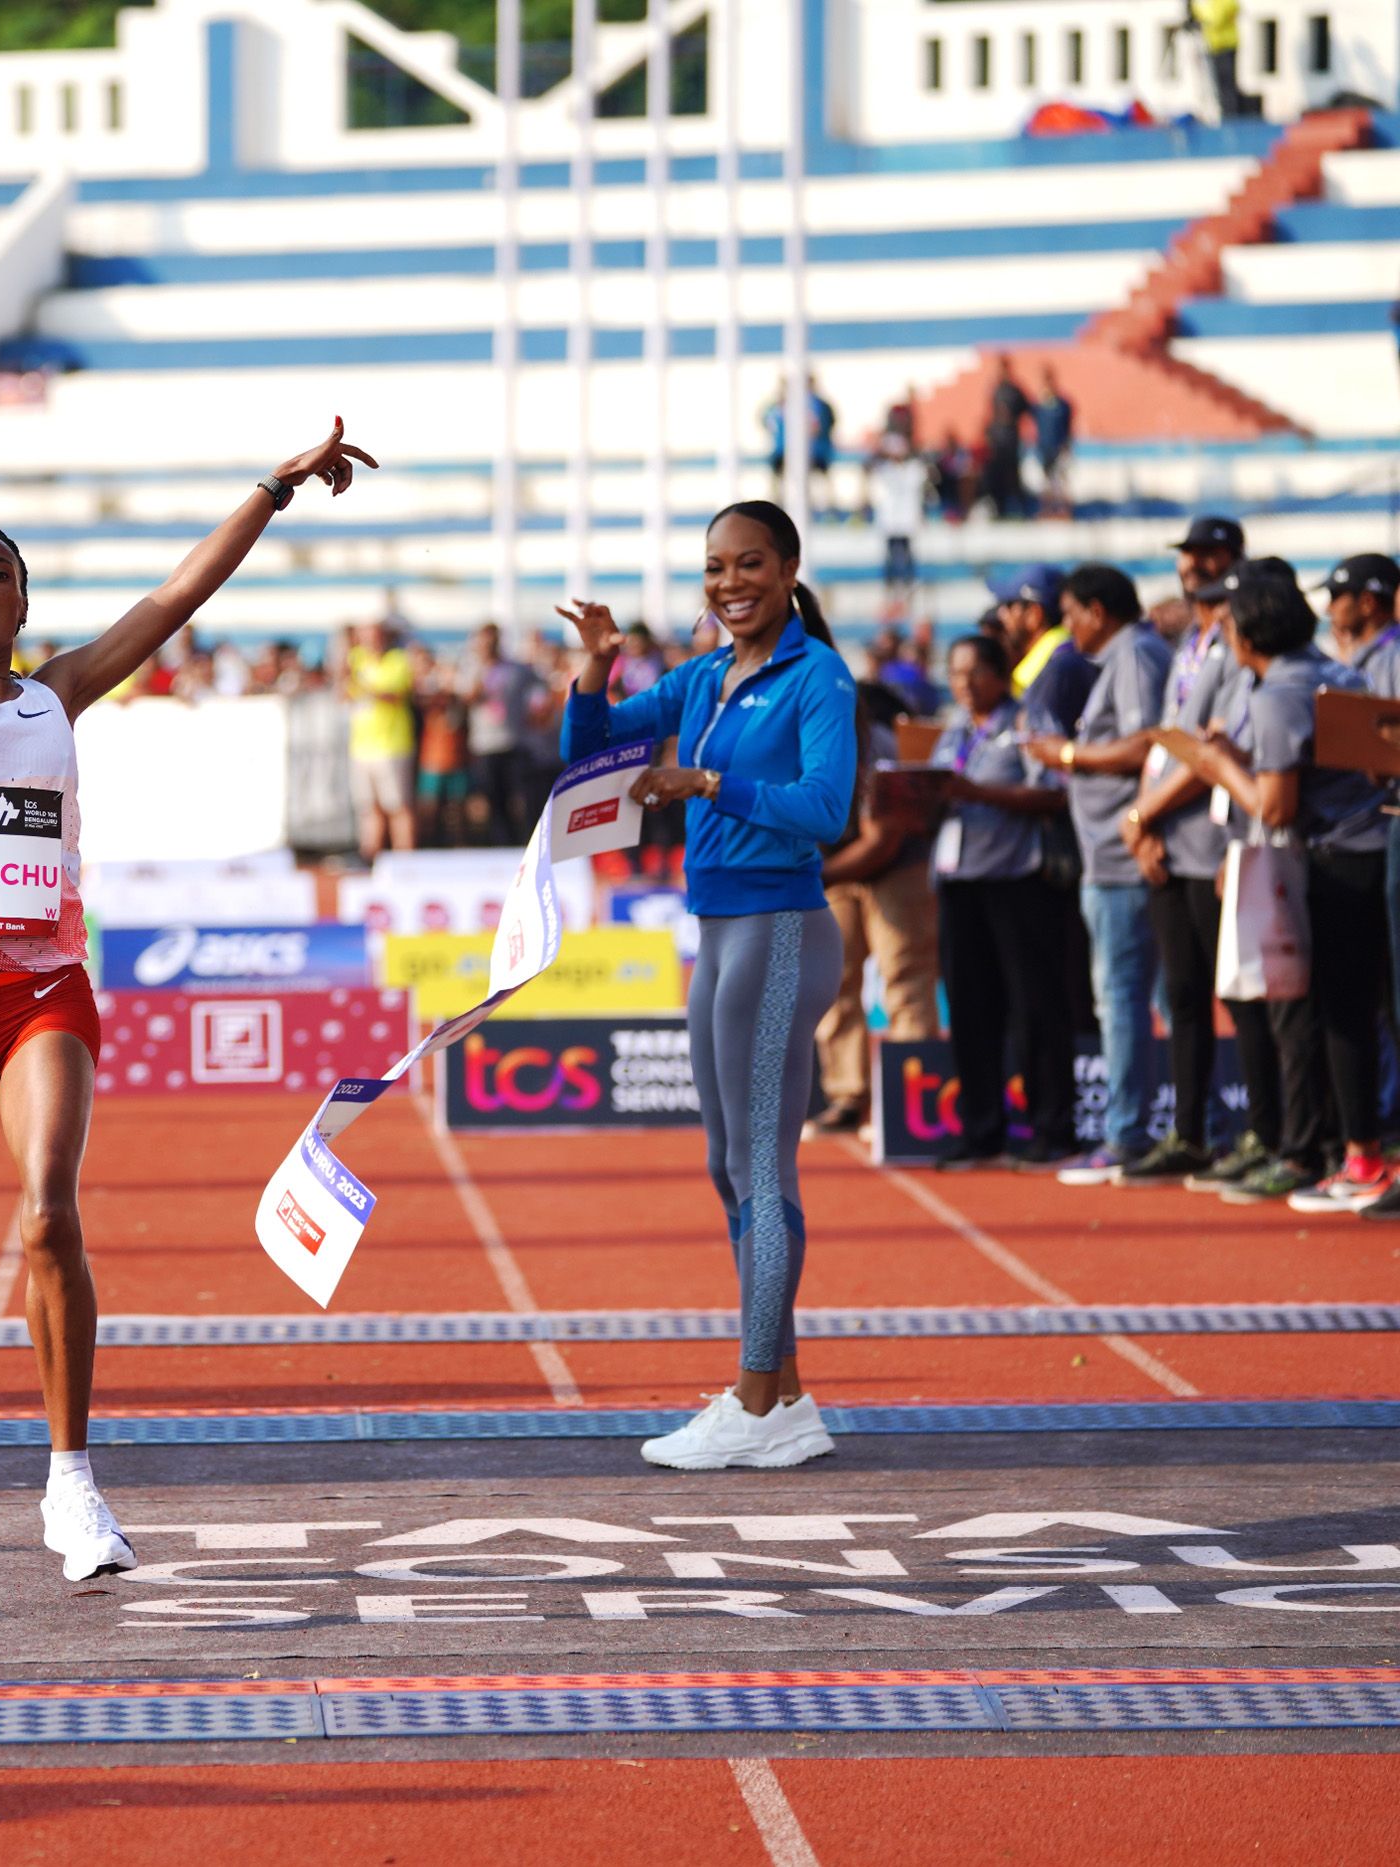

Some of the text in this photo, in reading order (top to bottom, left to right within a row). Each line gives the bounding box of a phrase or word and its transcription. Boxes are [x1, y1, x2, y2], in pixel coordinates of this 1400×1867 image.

[617, 745, 646, 763] 2023
[24, 799, 38, 809] tcs
[24, 809, 47, 817] WORLD
[24, 816, 58, 825] BENGALURU
[45, 907, 57, 919] W
[5, 922, 26, 931] Bank
[463, 1032, 603, 1113] tcs
[336, 1084, 365, 1095] 2023
[337, 1175, 368, 1211] 2023
[118, 1511, 1240, 1549] TATA
